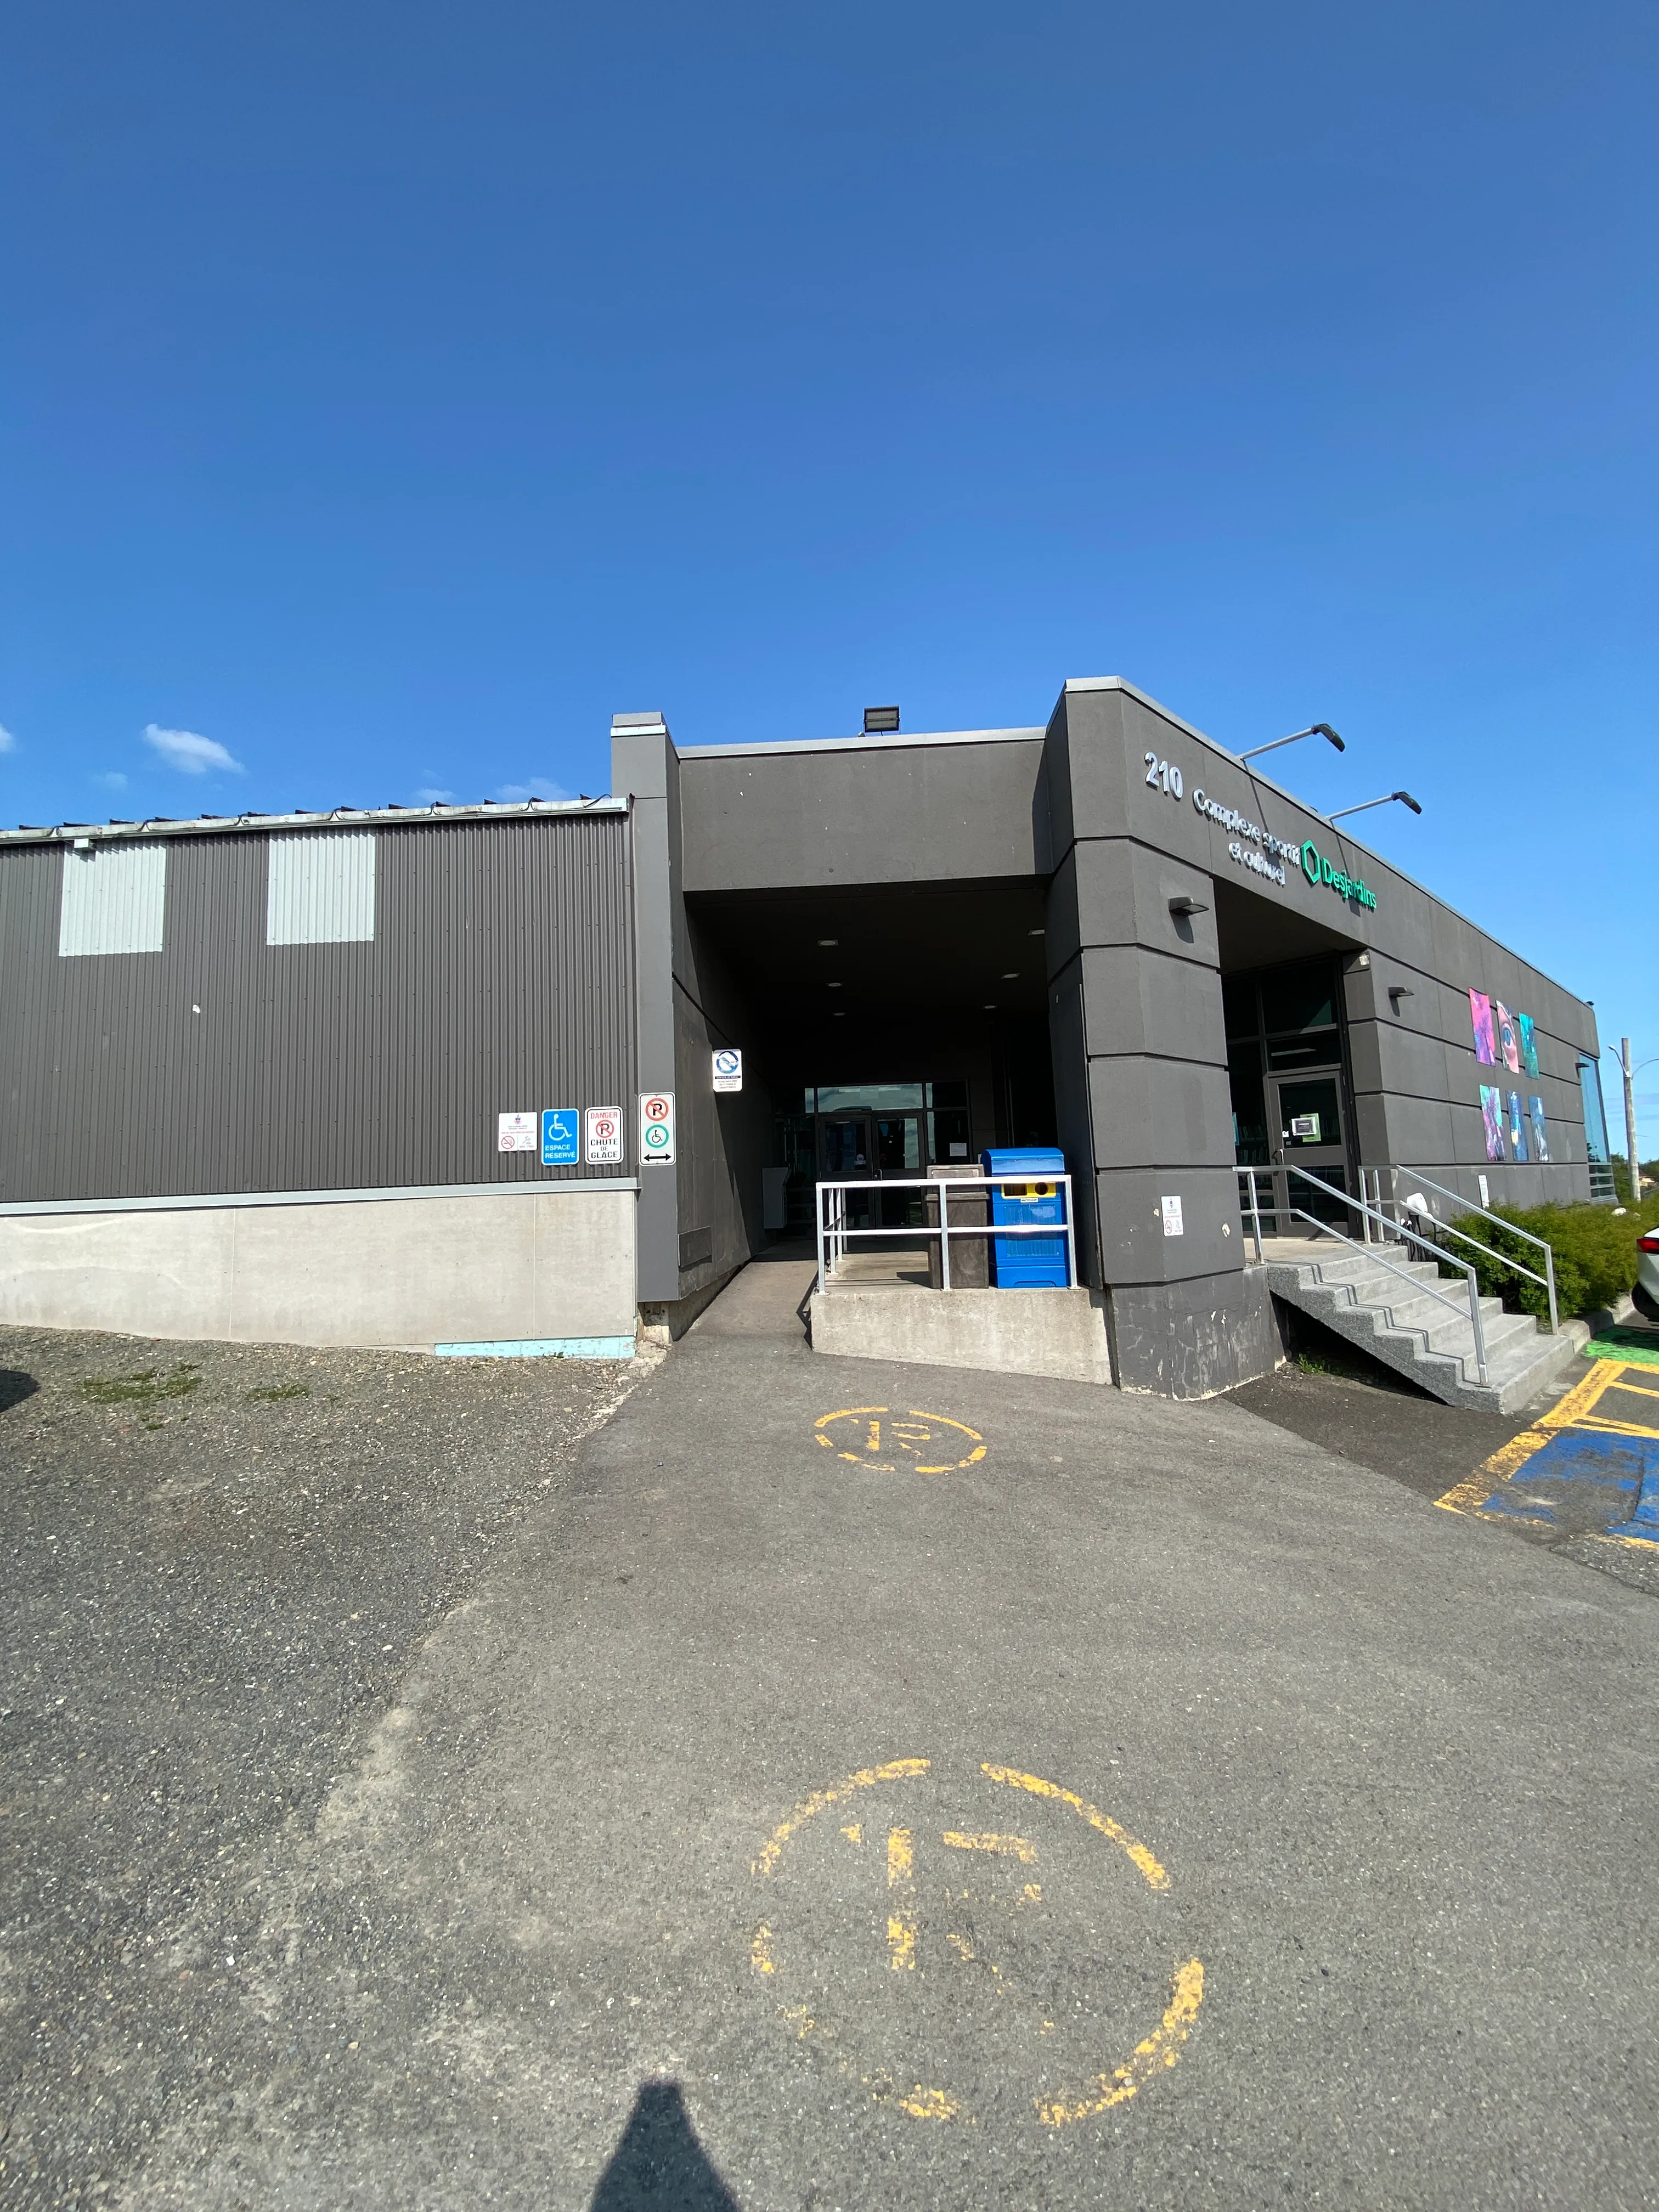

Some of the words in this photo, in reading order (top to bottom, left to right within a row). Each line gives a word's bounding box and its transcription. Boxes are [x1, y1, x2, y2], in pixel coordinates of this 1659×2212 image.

[1144, 752, 1184, 799] 210
[1193, 789, 1260, 842] Complexe
[1228, 843, 1243, 862] et
[1322, 856, 1378, 909] Desjardins
